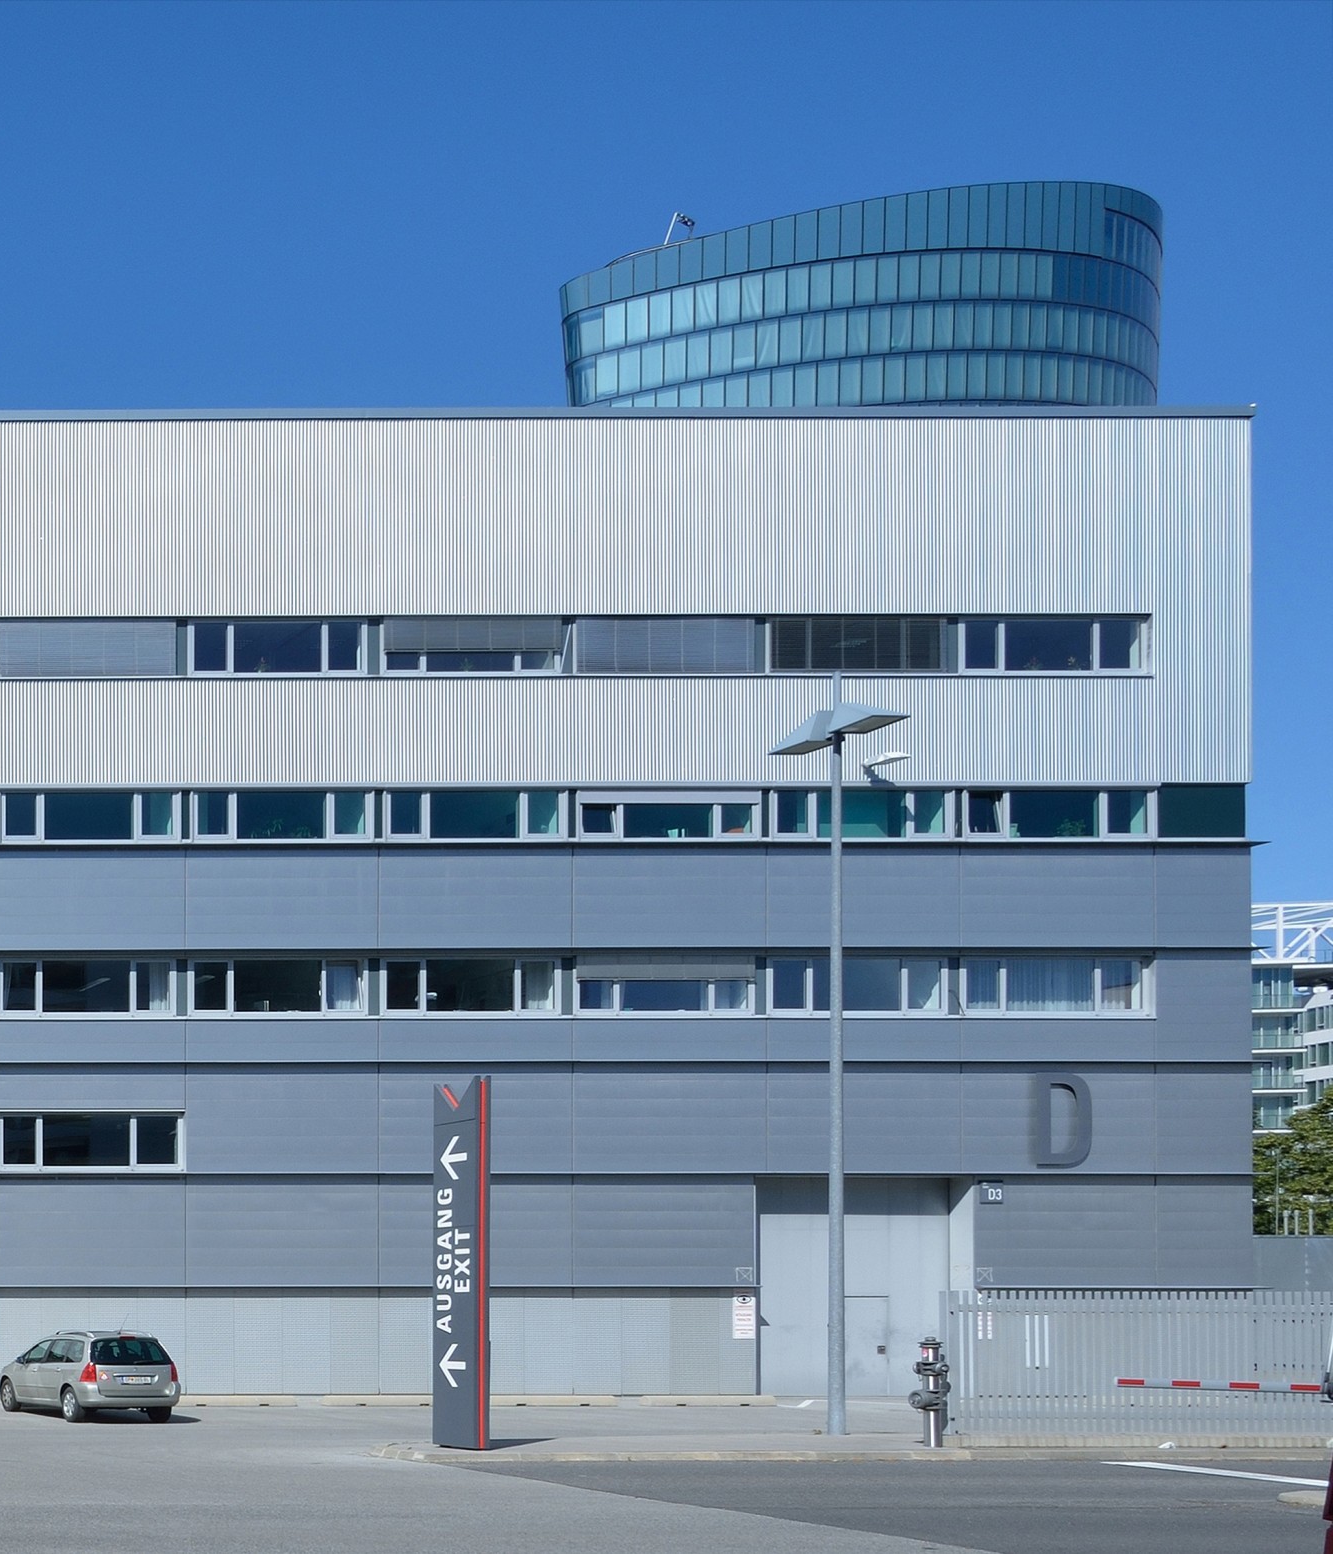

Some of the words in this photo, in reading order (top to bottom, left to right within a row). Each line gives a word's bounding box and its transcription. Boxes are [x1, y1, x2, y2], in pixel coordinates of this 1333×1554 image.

[1035, 1072, 1093, 1170] D
[988, 1188, 1002, 1200] D3
[436, 1187, 453, 1334] AUSGANG
[454, 1228, 471, 1293] EXIT
